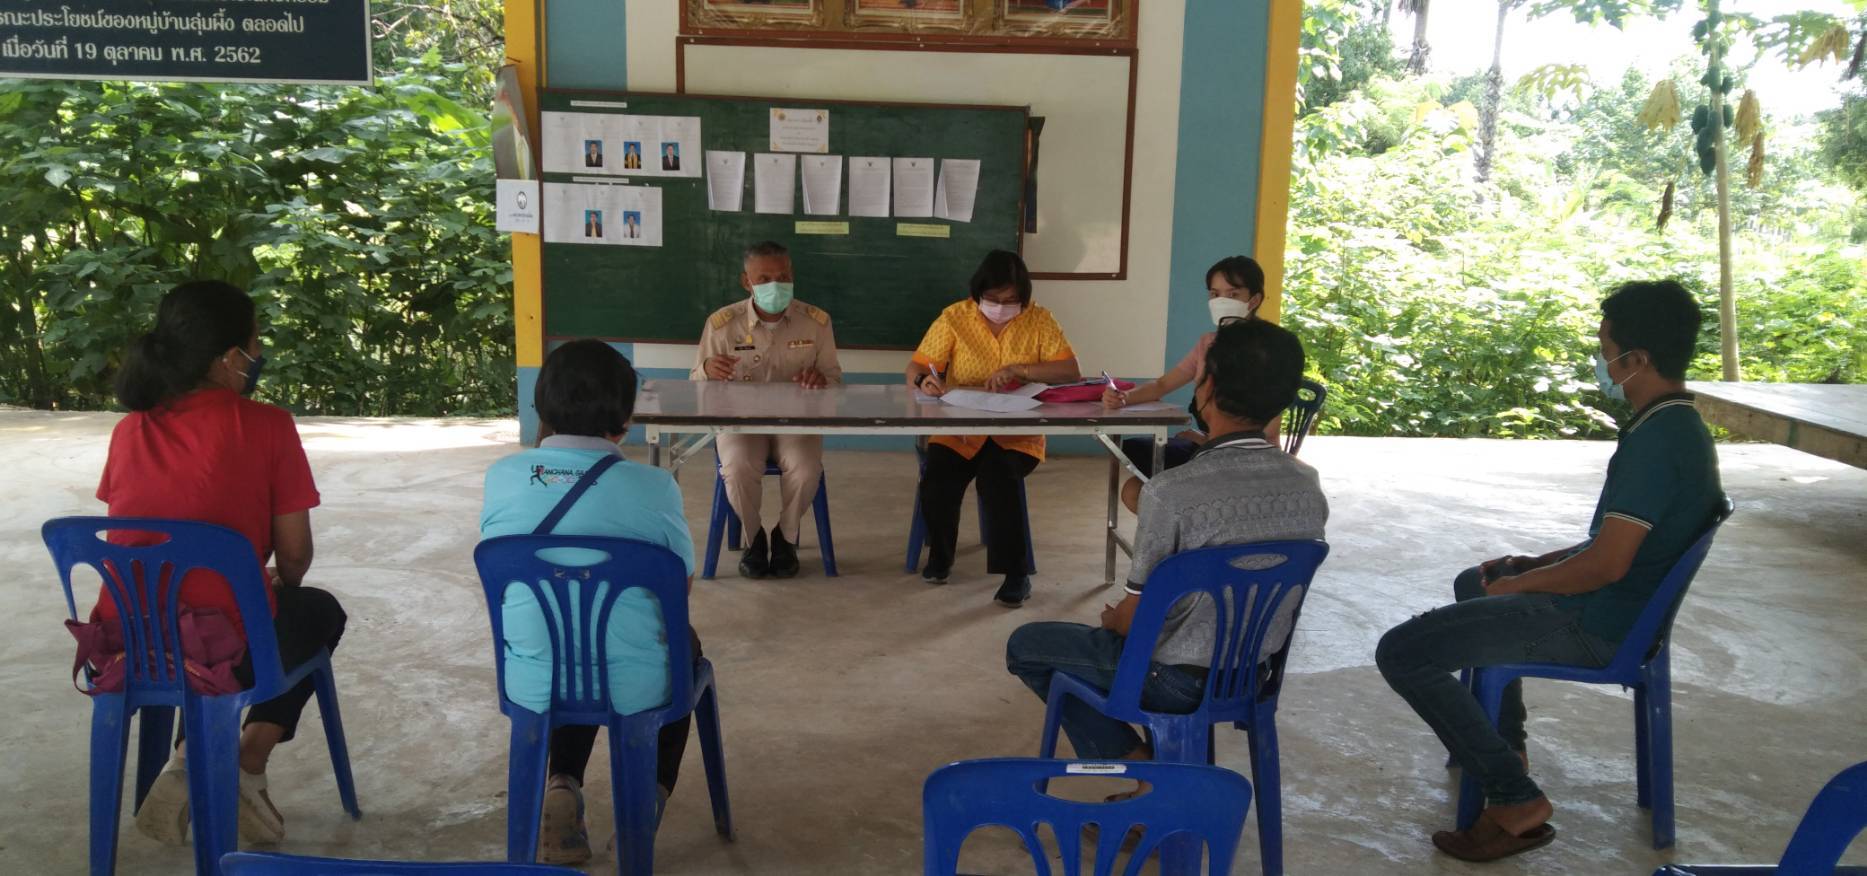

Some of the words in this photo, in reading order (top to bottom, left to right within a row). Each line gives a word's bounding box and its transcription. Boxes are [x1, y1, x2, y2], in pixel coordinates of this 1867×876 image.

[242, 11, 304, 33] ตลอดไป
[2, 34, 68, 59] เมื่อวันที่
[74, 42, 97, 60] 19
[103, 45, 162, 66] ตุลาคม
[171, 46, 207, 62] พ.ศ.
[214, 45, 261, 64] 2562
